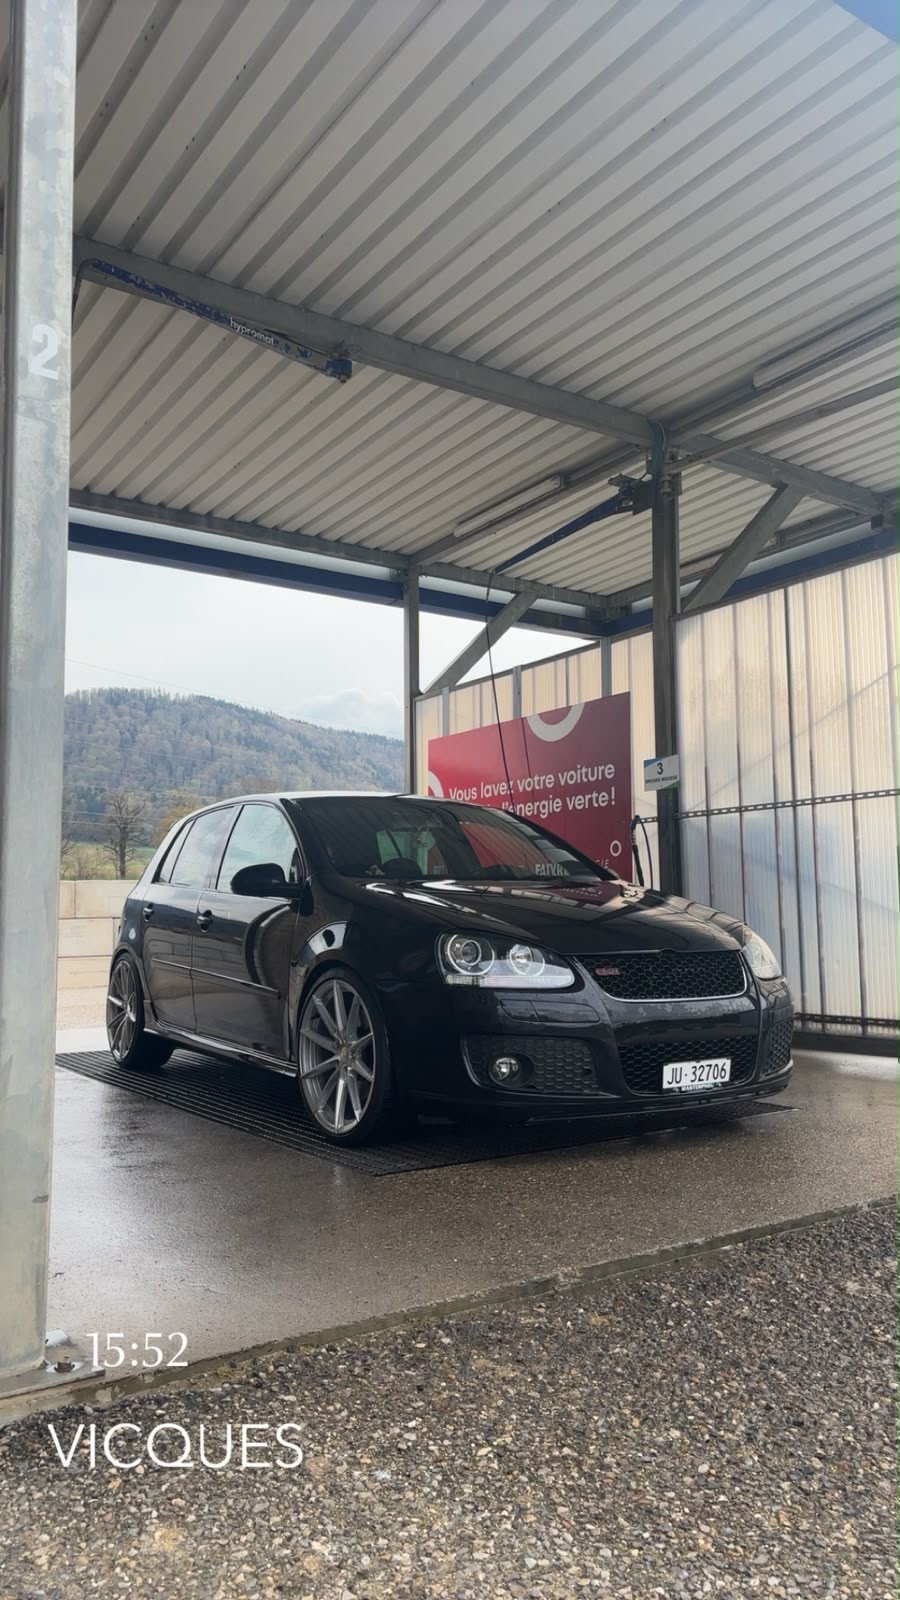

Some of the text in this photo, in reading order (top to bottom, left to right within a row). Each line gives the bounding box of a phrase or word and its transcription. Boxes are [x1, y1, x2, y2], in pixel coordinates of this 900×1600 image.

[656, 762, 664, 775] 3
[448, 787, 478, 801] Vous
[517, 774, 555, 793] votre
[558, 763, 615, 786] voiture
